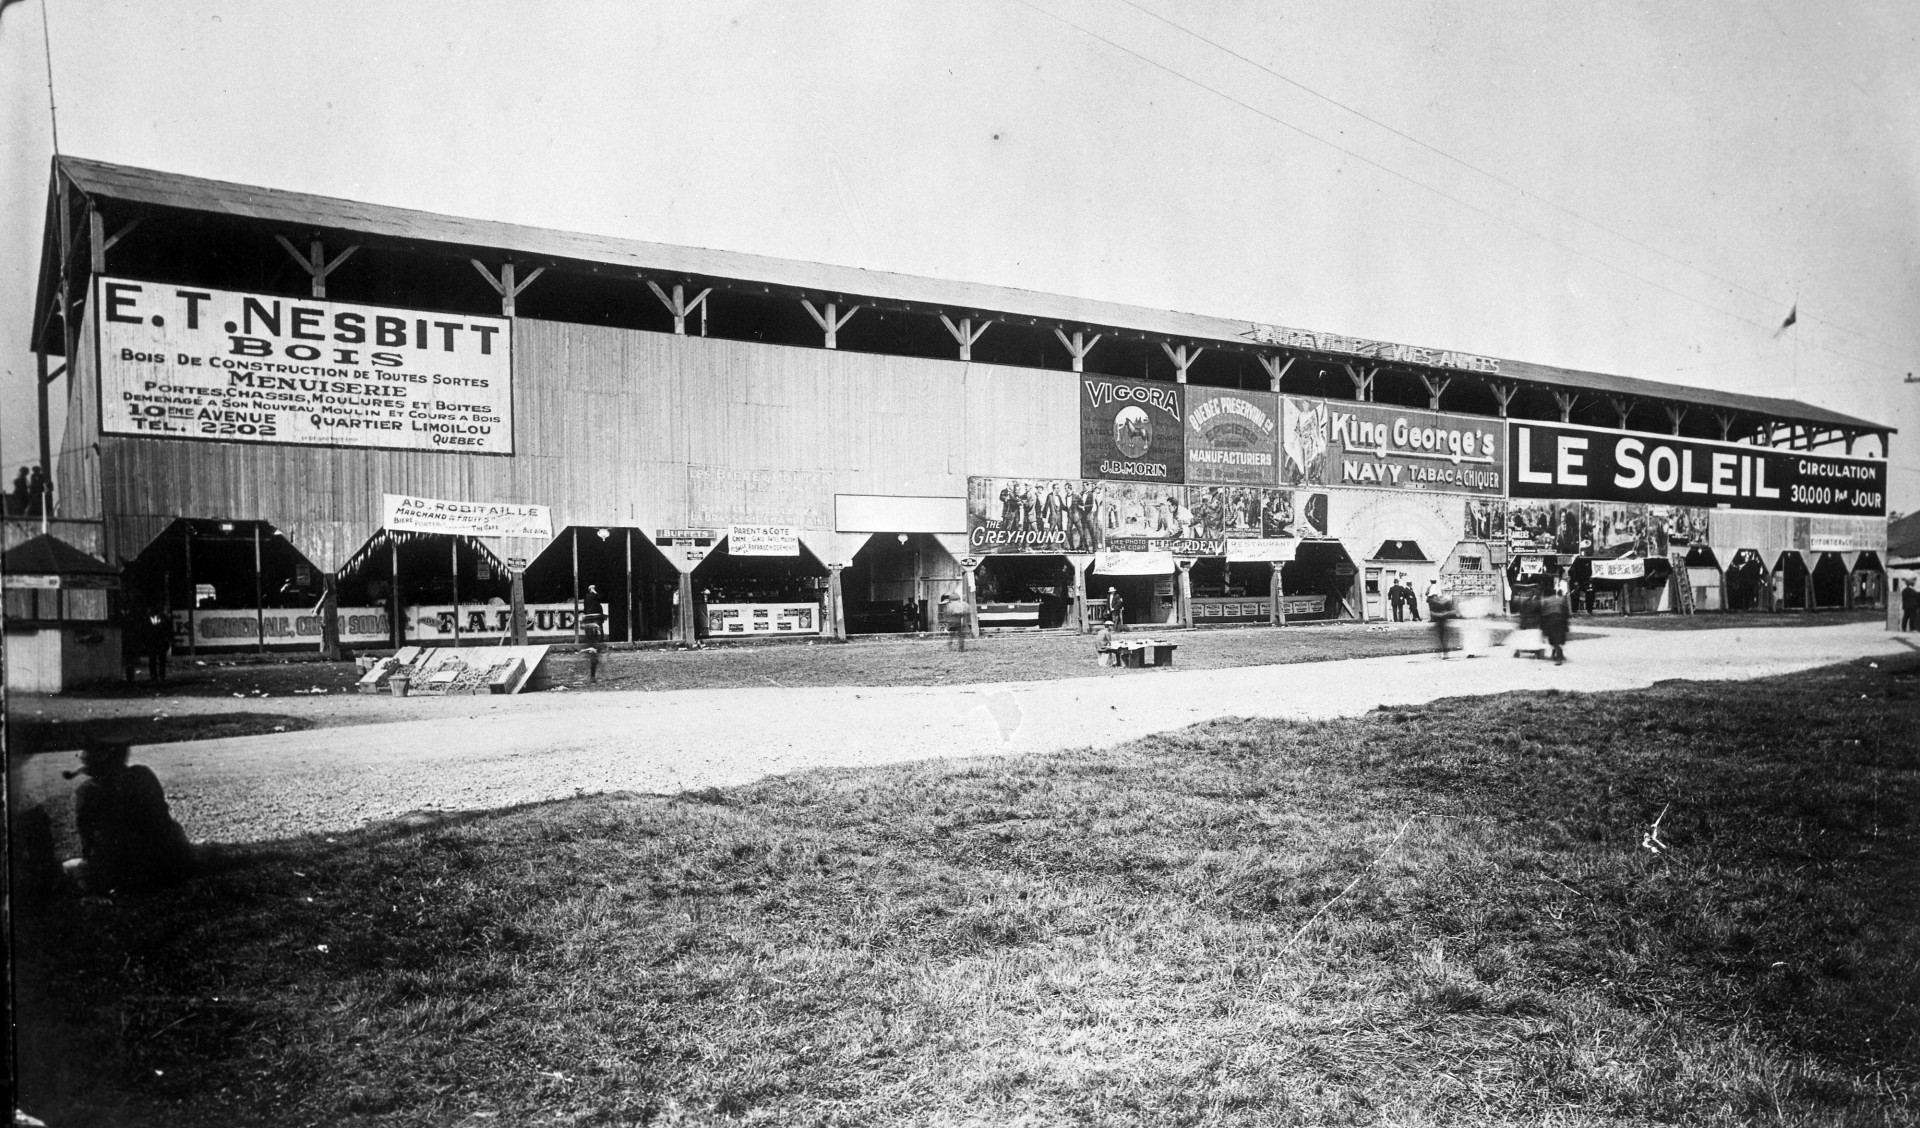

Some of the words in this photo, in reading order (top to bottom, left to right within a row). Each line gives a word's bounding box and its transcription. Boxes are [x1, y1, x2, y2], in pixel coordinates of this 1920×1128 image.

[228, 335, 404, 368] BOIS
[1393, 343, 1433, 365] VUES
[121, 347, 166, 364] BOIS
[177, 352, 203, 367] DE
[209, 356, 348, 379] CONSTRUCTION
[353, 369, 370, 380] DE
[374, 369, 428, 384] TOUTES
[432, 373, 490, 389] SORTES
[228, 370, 407, 398] MENUISERIE
[221, 398, 249, 409] SON
[252, 401, 315, 413] NOUVEAU
[321, 405, 381, 418] MOULIN
[388, 410, 405, 418] ET
[408, 410, 456, 422] COURS
[472, 413, 501, 424] BOIS
[312, 393, 405, 409] MOULURES
[412, 401, 430, 411] ET
[435, 400, 492, 414] BOITES
[1084, 380, 1181, 423] VIGORA
[197, 407, 277, 425] AVENUE
[310, 413, 404, 431] QUARTIER
[411, 419, 492, 435] LIMOILOU
[1188, 397, 1220, 433] QUEBEC
[1220, 396, 1266, 429] PRESERVING
[131, 416, 186, 433] TEL.
[200, 421, 277, 437] 2202
[432, 433, 485, 447] QUEBEC
[1330, 411, 1389, 458] King
[1393, 417, 1496, 465] George's
[1189, 449, 1272, 467] MANUFACTURIERS
[1518, 426, 1589, 487] LE
[1613, 436, 1781, 499] SOLEIL
[1343, 459, 1403, 484] NAVY
[1408, 464, 1454, 483] TABAC
[1463, 469, 1500, 489] CHIQUER
[1798, 459, 1876, 480] CIRCULATION
[1790, 483, 1831, 506] 30,000
[1851, 488, 1882, 508] JOUR
[395, 507, 448, 521] MARCHAND
[985, 519, 1001, 530] THE
[663, 529, 710, 538] BUFFETS
[733, 526, 761, 536] PARENT
[769, 527, 790, 536] COTE
[970, 526, 1067, 547] GREYHOUND
[1230, 541, 1291, 549] RESTAURANT
[348, 615, 390, 635] SODA
